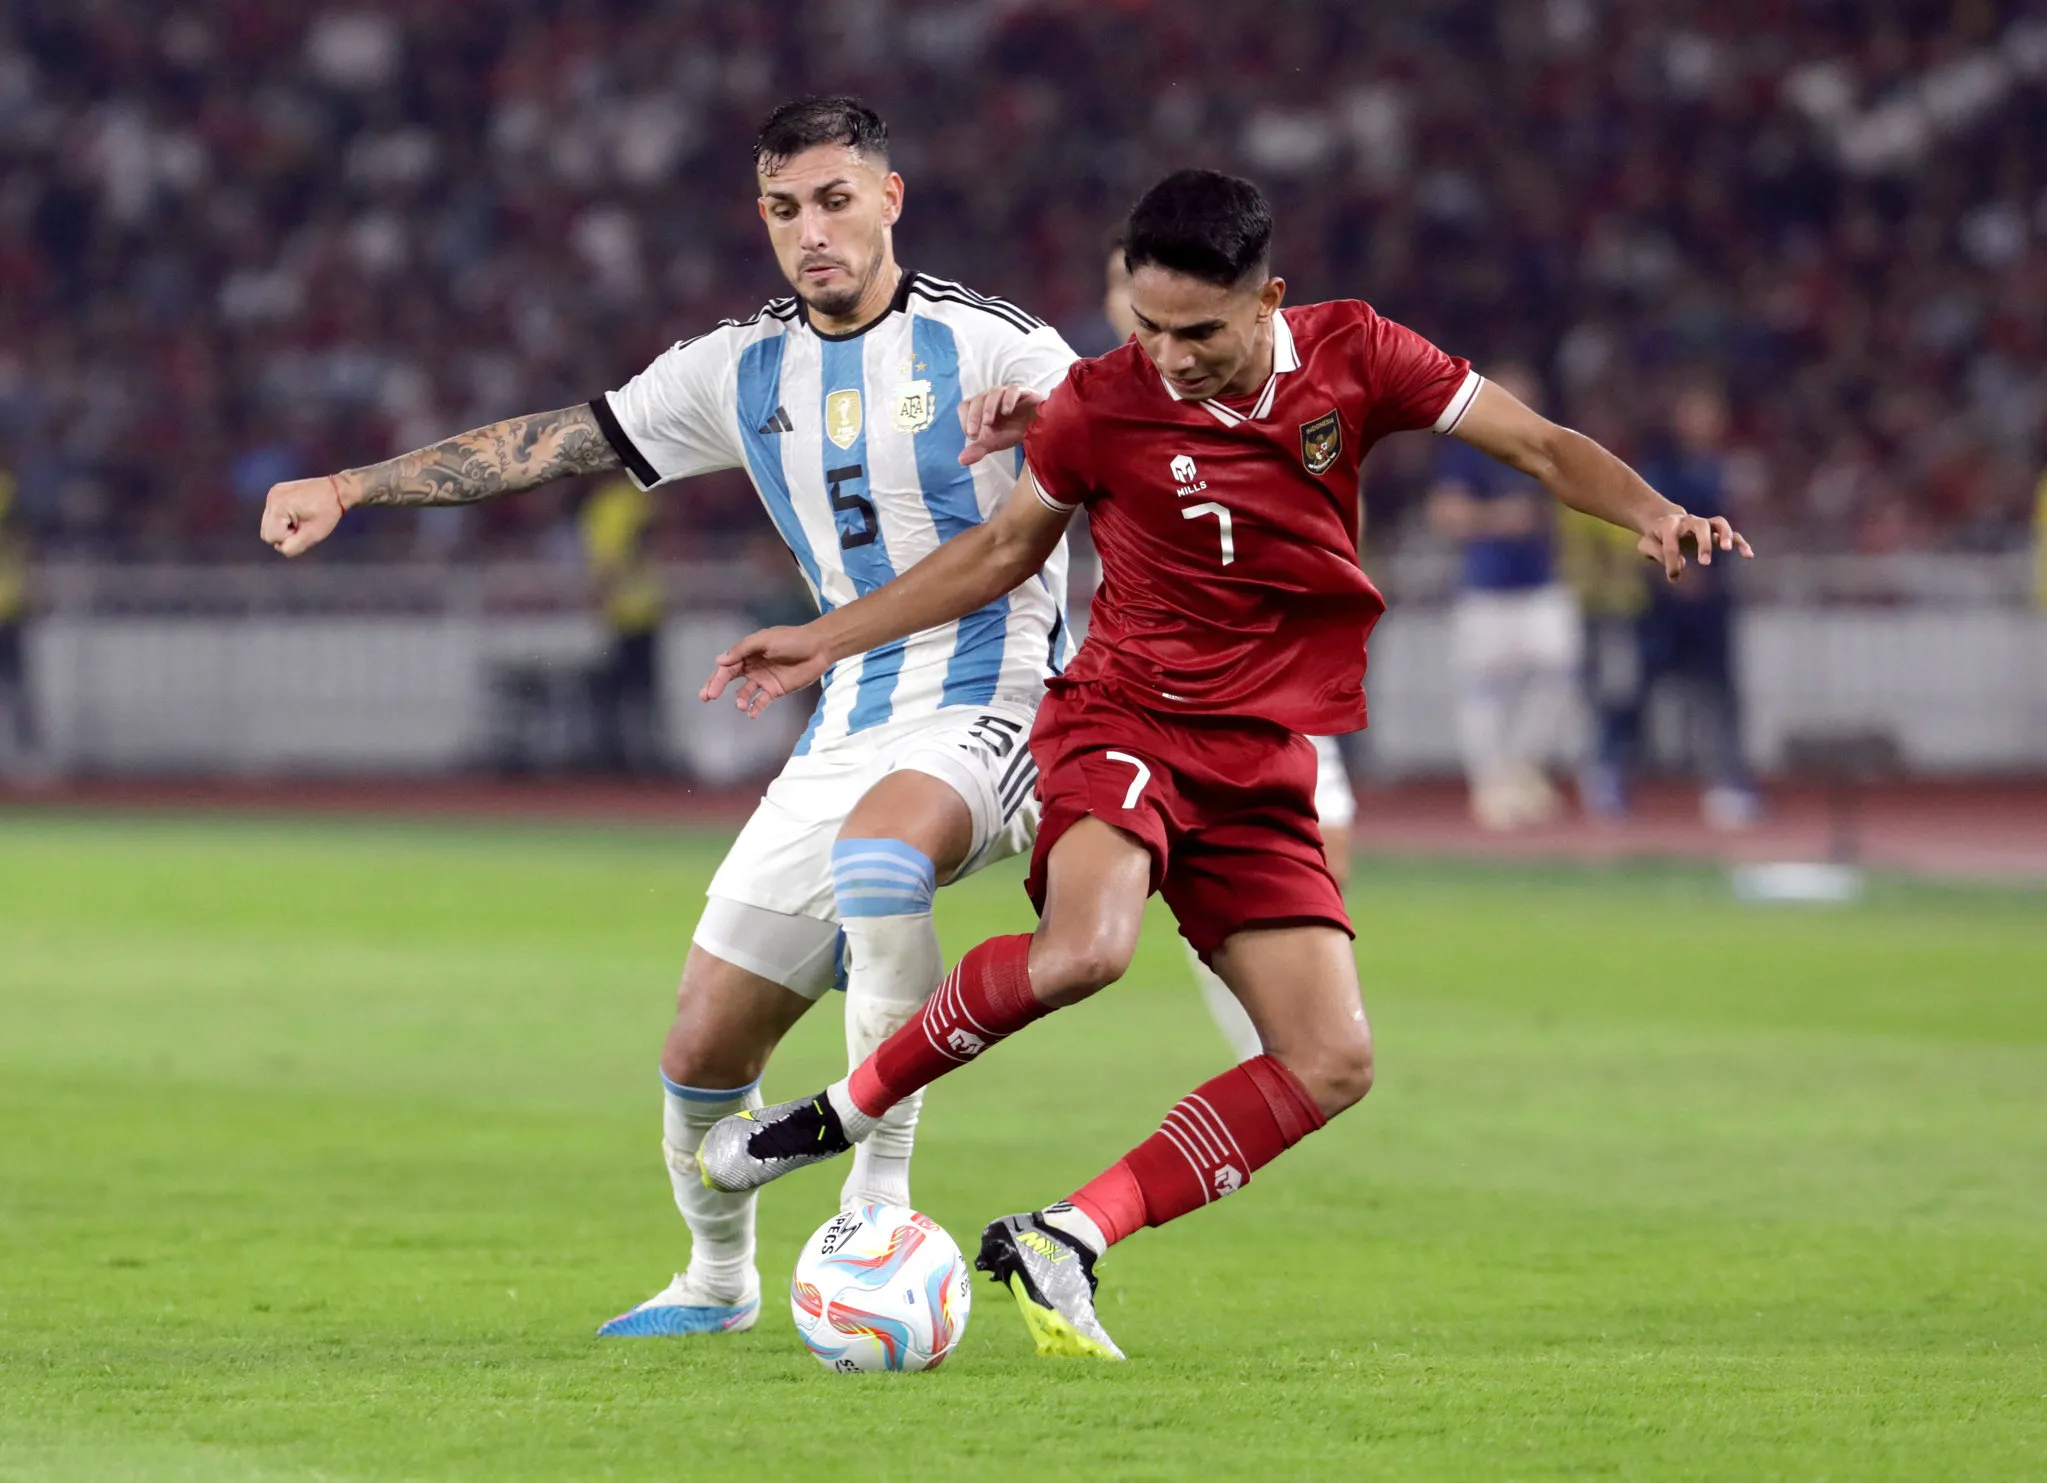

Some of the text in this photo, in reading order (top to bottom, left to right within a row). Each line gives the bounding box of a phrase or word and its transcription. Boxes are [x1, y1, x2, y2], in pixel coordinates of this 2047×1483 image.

[900, 395, 924, 419] AFA
[827, 465, 879, 550] 5
[1177, 481, 1207, 497] MILLS
[1181, 502, 1235, 567] 7
[1106, 751, 1152, 810] 7
